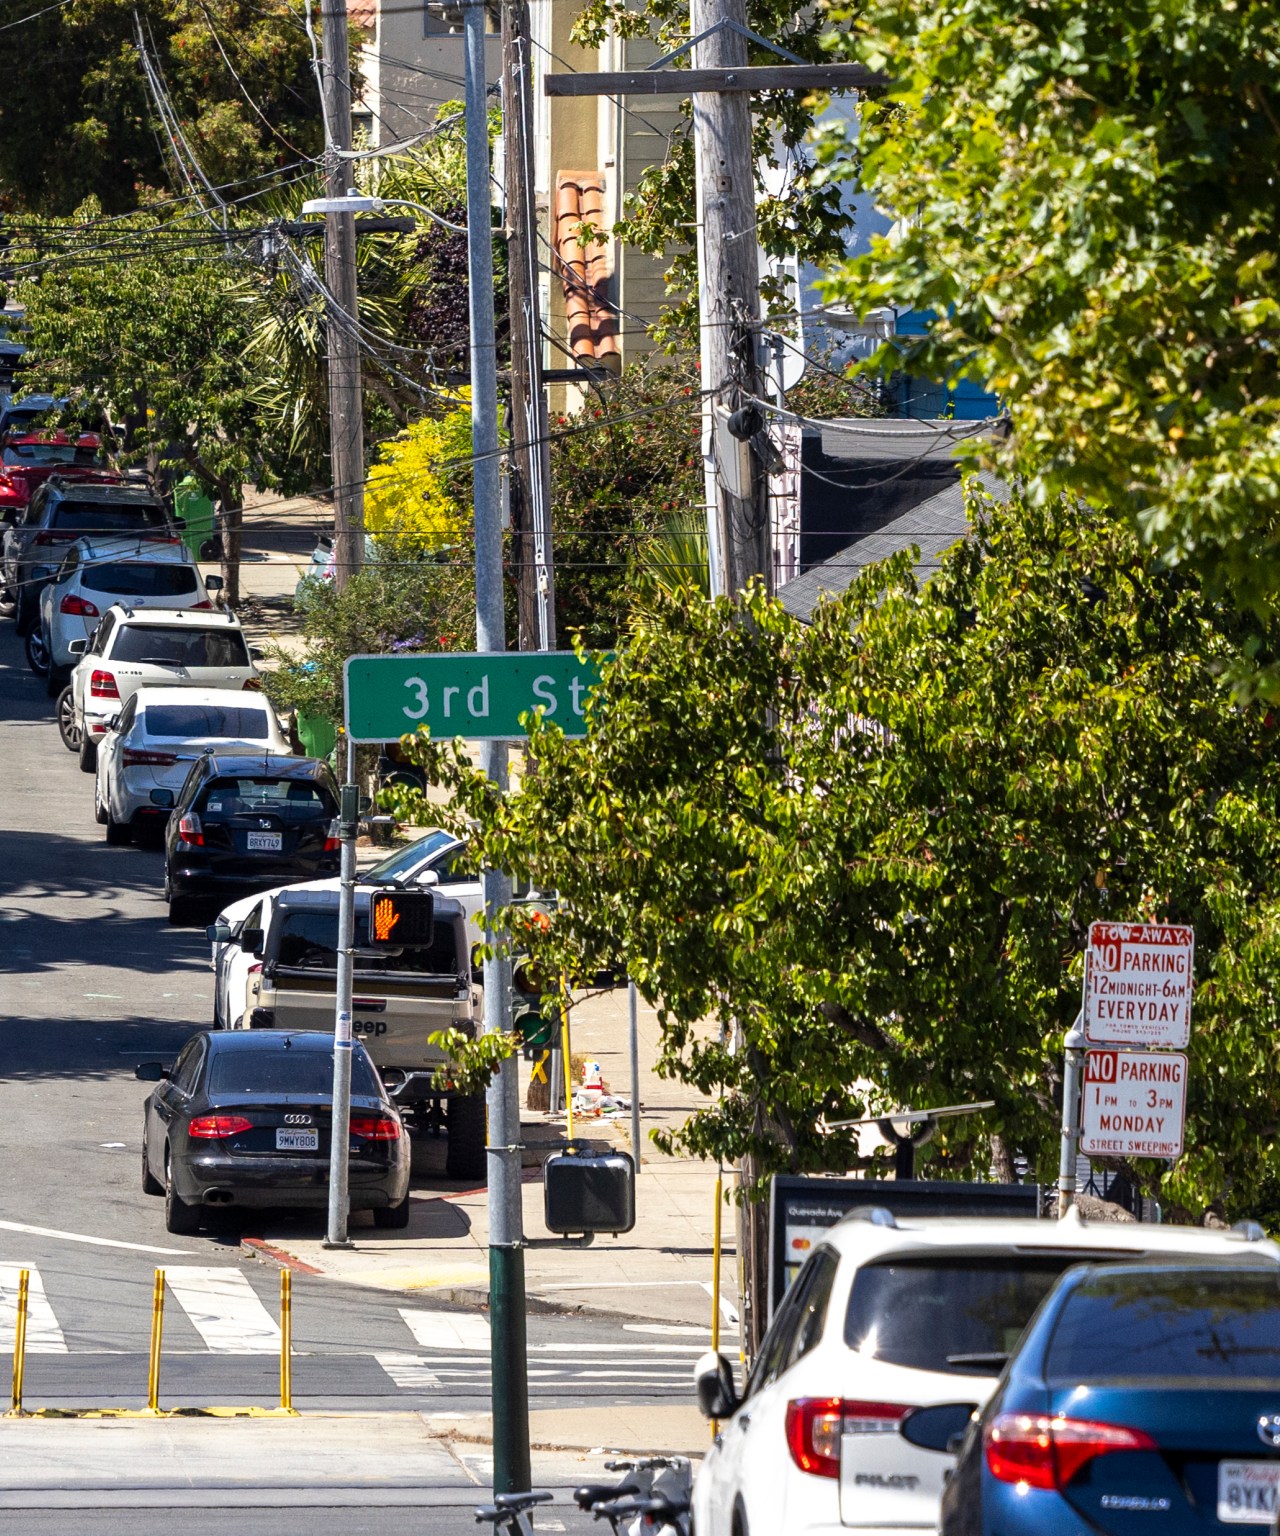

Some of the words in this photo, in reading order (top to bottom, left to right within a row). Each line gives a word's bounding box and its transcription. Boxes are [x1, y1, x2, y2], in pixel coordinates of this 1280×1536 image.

[402, 674, 490, 719] 3rd
[530, 674, 585, 717] St
[1100, 926, 1184, 943] TOW-AWAY
[1093, 944, 1118, 971] NO
[1123, 951, 1185, 974] PARKING
[1097, 999, 1179, 1022] EVERYDAY
[352, 1020, 387, 1037] eep
[1088, 1053, 1114, 1081] NO
[1121, 1061, 1180, 1083] PARKING
[1095, 1087, 1100, 1106] 1
[1104, 1095, 1118, 1106] PM
[1129, 1099, 1137, 1108] TO
[1146, 1089, 1157, 1108] 3
[1159, 1098, 1173, 1109] PM
[1100, 1113, 1164, 1133] MONDAY
[1089, 1138, 1124, 1151] STREET
[1127, 1140, 1173, 1153] SWEEPING
